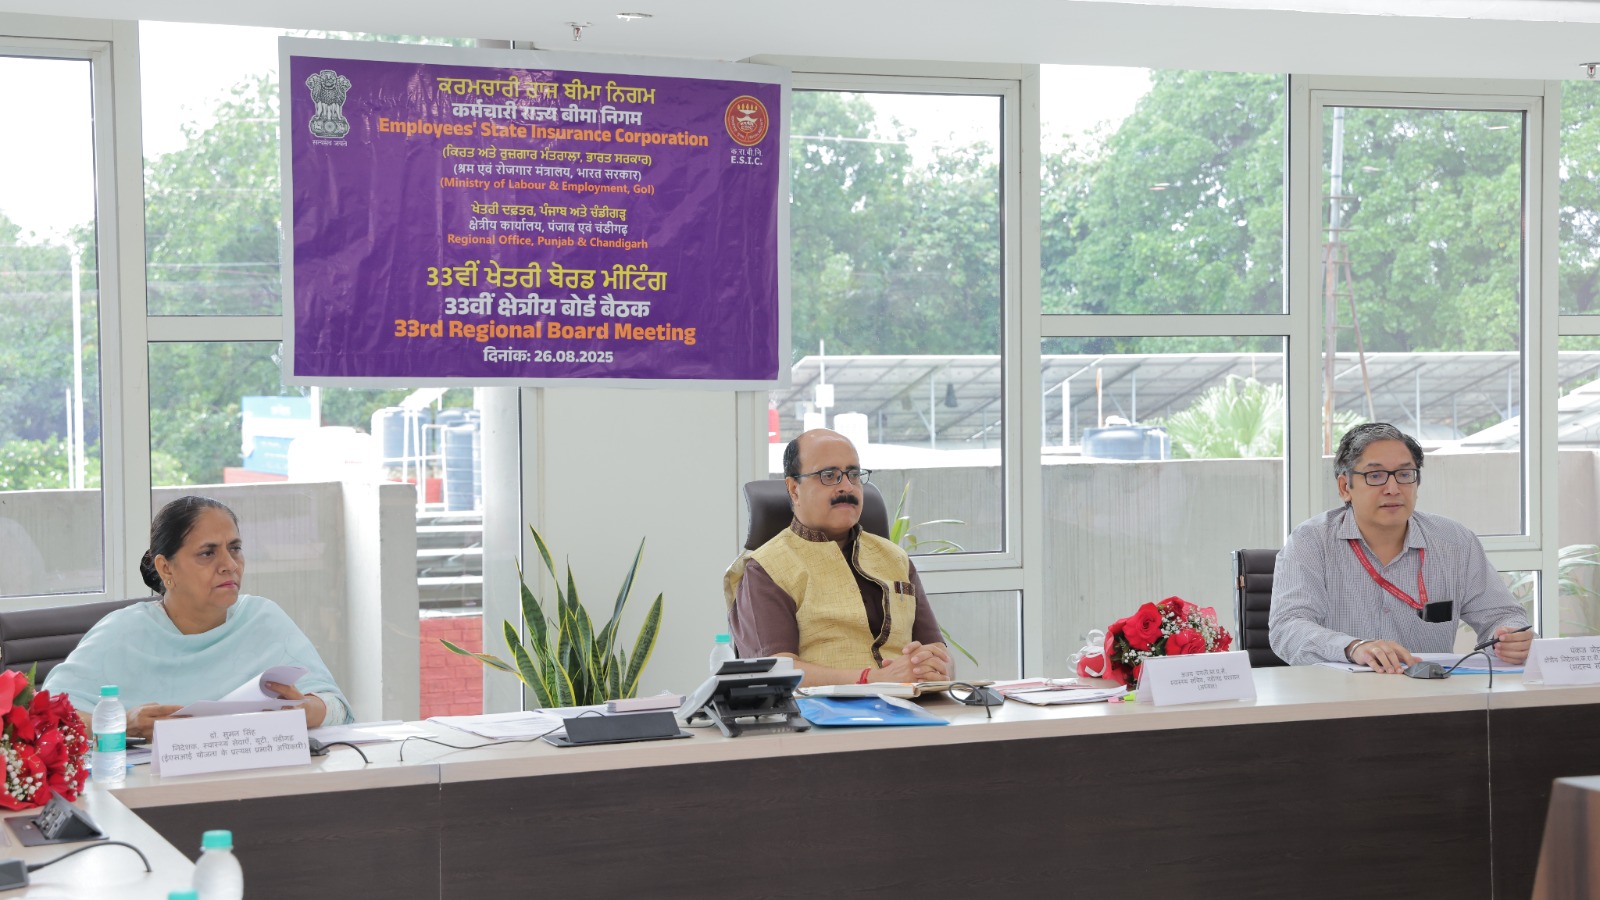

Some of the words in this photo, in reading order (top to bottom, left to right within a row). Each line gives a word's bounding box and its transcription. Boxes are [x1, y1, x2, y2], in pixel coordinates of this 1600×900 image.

[437, 76, 519, 98] ਕਰਮਚਾਰੀ
[563, 79, 602, 101] ਬੀਮਾ
[605, 80, 656, 104] ਨਿਗਮ
[452, 99, 517, 120] कर्मचारी
[521, 105, 558, 122] राज्य
[560, 104, 597, 123] बीमा
[599, 105, 642, 125] निगम
[379, 117, 477, 137] Employees'
[481, 123, 527, 137] State
[531, 125, 612, 142] Insurance
[615, 128, 709, 146] Corporation
[443, 144, 475, 159] (ਕਿਰਤ
[478, 145, 497, 159] ਅਤੇ
[585, 152, 612, 163] ਭਾਰਤ
[614, 153, 652, 166] ਸਰਕਾਰ)
[731, 156, 763, 165] E.S.I.C.
[454, 163, 474, 176] (श्रम
[477, 163, 493, 176] एवं
[496, 162, 533, 176] रोजगार
[535, 165, 574, 179] मंत्रालय,
[577, 168, 602, 180] भारत
[604, 170, 642, 182] सरकार)
[440, 177, 490, 190] (Ministry
[493, 178, 506, 189] of
[508, 179, 546, 190] Labour
[549, 181, 560, 190] &
[562, 181, 631, 195] Employment,
[471, 201, 499, 215] ਖੇਤਰੀ
[539, 203, 567, 216] ਪੰਜਾਬ
[570, 205, 587, 218] ਅਤੇ
[469, 217, 497, 231] क्षेत्रीय
[500, 218, 544, 233] कार्यालय,
[547, 220, 575, 232] पंजाब
[578, 221, 592, 233] एवं
[595, 221, 628, 236] चंडीगढ़
[447, 234, 495, 246] Regional
[498, 235, 534, 247] Office,
[537, 236, 574, 248] Punjab
[577, 237, 587, 246] &
[590, 237, 648, 250] Chandigarh
[427, 260, 480, 286] 33ਵੀਂ
[484, 260, 542, 288] ਖੇਤਰੀ
[547, 262, 596, 289] ਬੋਰਡ
[601, 264, 667, 291] ਮੀਟਿੰਗ
[444, 292, 495, 315] 33वीं
[498, 292, 556, 317] क्षेत्रीय
[561, 293, 596, 317] बोर्ड
[600, 294, 651, 318] बैठक
[394, 319, 443, 338] 33rd
[449, 319, 542, 342] Regional
[547, 321, 609, 340] Board
[614, 322, 696, 346] Meeting
[483, 346, 531, 363] दिनांक:
[534, 350, 614, 363] 26.08.2025
